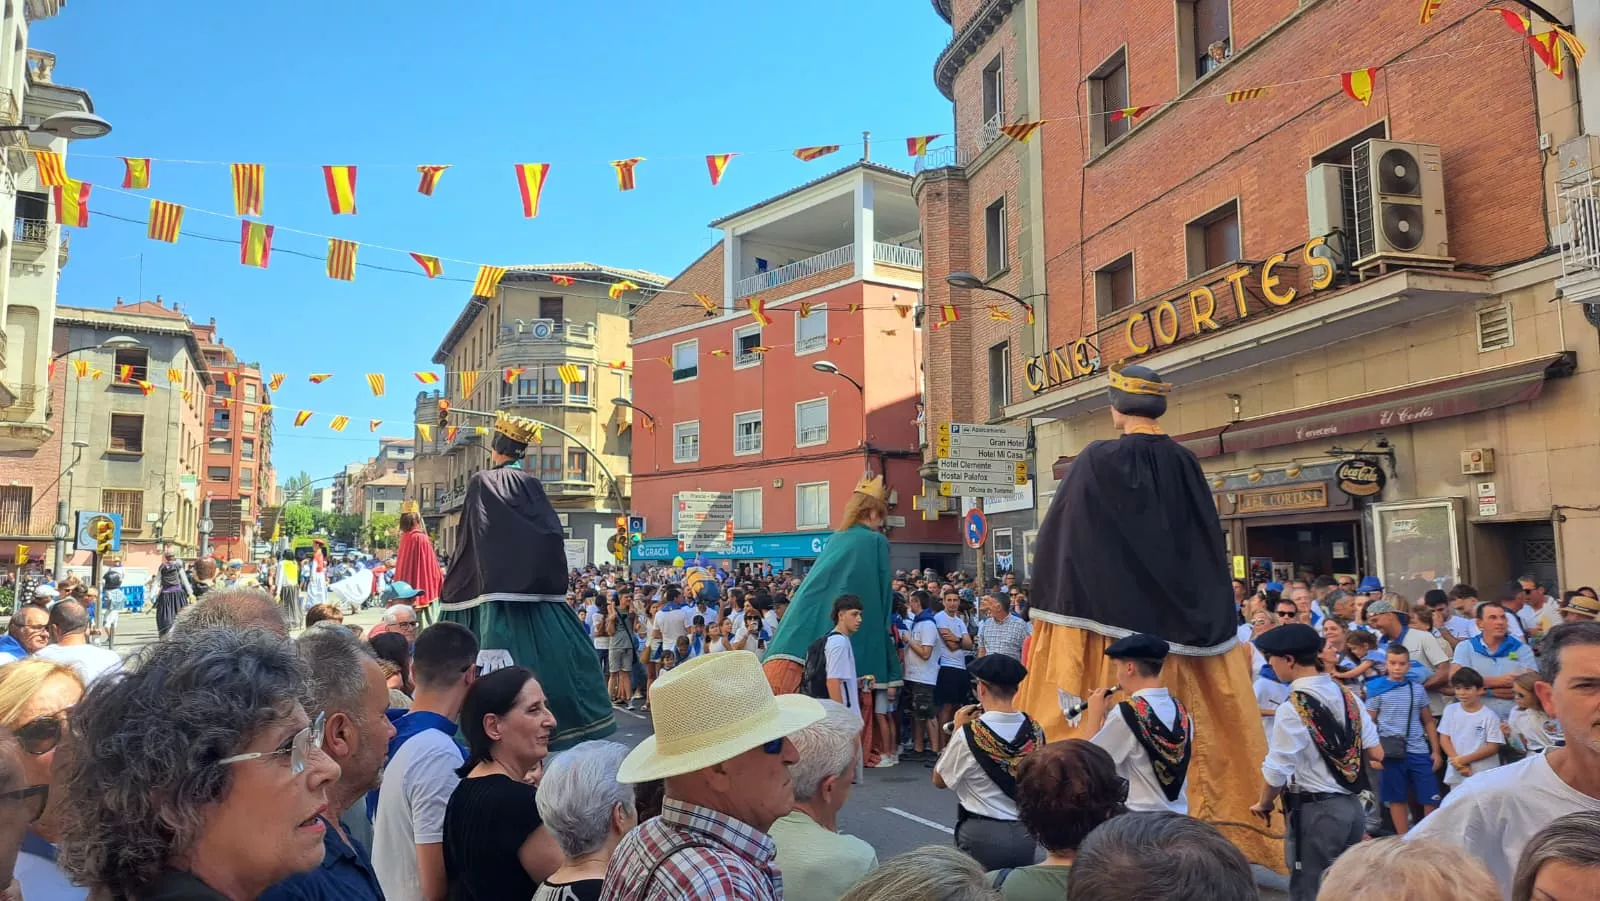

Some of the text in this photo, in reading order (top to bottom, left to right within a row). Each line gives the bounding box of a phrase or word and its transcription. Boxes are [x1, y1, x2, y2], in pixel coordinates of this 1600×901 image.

[1024, 235, 1335, 393] CINE CORTES
[1380, 410, 1393, 426] El
[989, 438, 1025, 448] Gran Hotel
[978, 449, 1024, 460] Hotel Mi Casa
[960, 461, 992, 470] Clemente
[941, 471, 988, 481] Hostal Palafox
[645, 546, 670, 557] GRACIA
